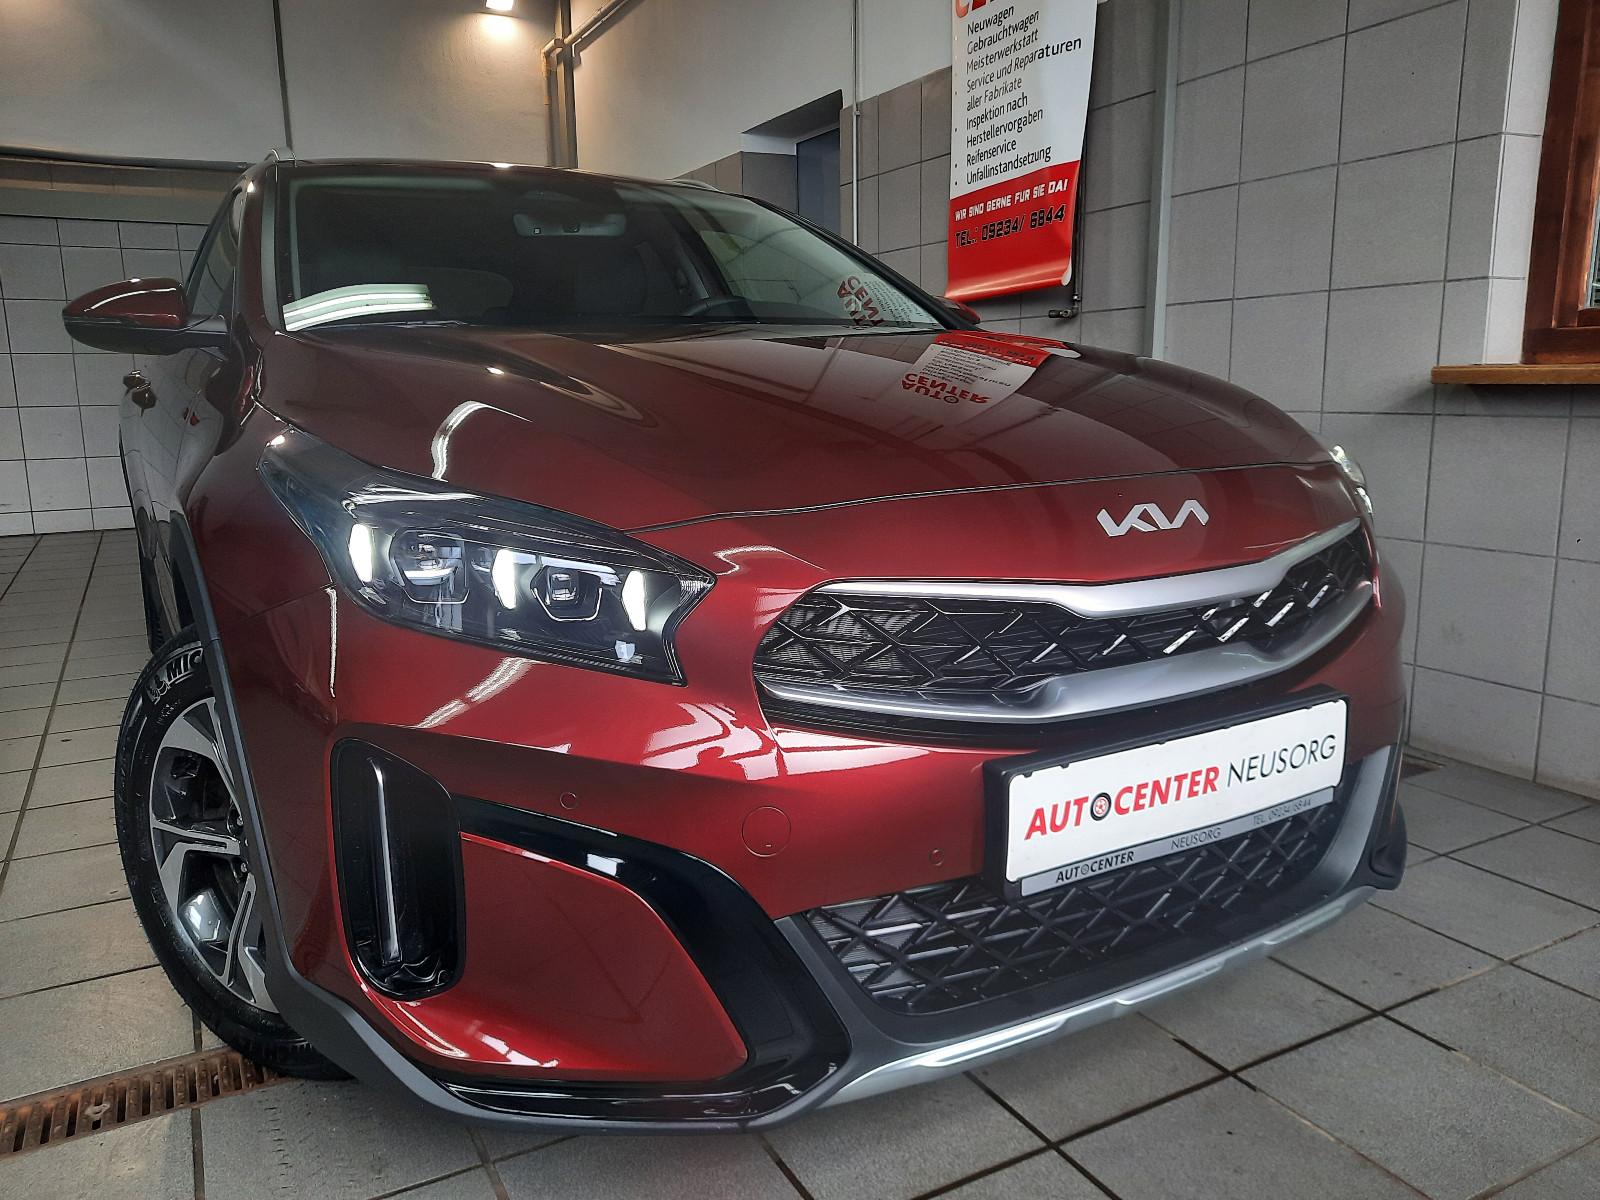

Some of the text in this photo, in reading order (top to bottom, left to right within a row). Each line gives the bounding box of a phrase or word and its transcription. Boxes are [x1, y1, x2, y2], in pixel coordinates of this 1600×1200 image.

[967, 6, 1014, 36] Neuwagen
[967, 10, 1040, 54] Gebrauchtwagen
[966, 28, 1039, 75] Meisterwerkstatt
[966, 38, 1082, 93] Service und Reparaturen
[966, 78, 1022, 112] aller Fabrikate
[966, 92, 1028, 131] Inspektion nach
[966, 109, 1043, 149] Herstellervorgaben
[966, 139, 1017, 167] Reifenservice
[966, 145, 1051, 185] Unfallinstandsetzung
[955, 208, 966, 222] WIR
[969, 203, 984, 218] SIND
[986, 195, 1012, 212] GERNE
[1033, 184, 1045, 199] SIE
[1030, 204, 1067, 229] 6844
[1096, 499, 1210, 537] KIA
[1227, 734, 1336, 788] NEUSORG
[1171, 827, 1221, 850] NEUSORG
